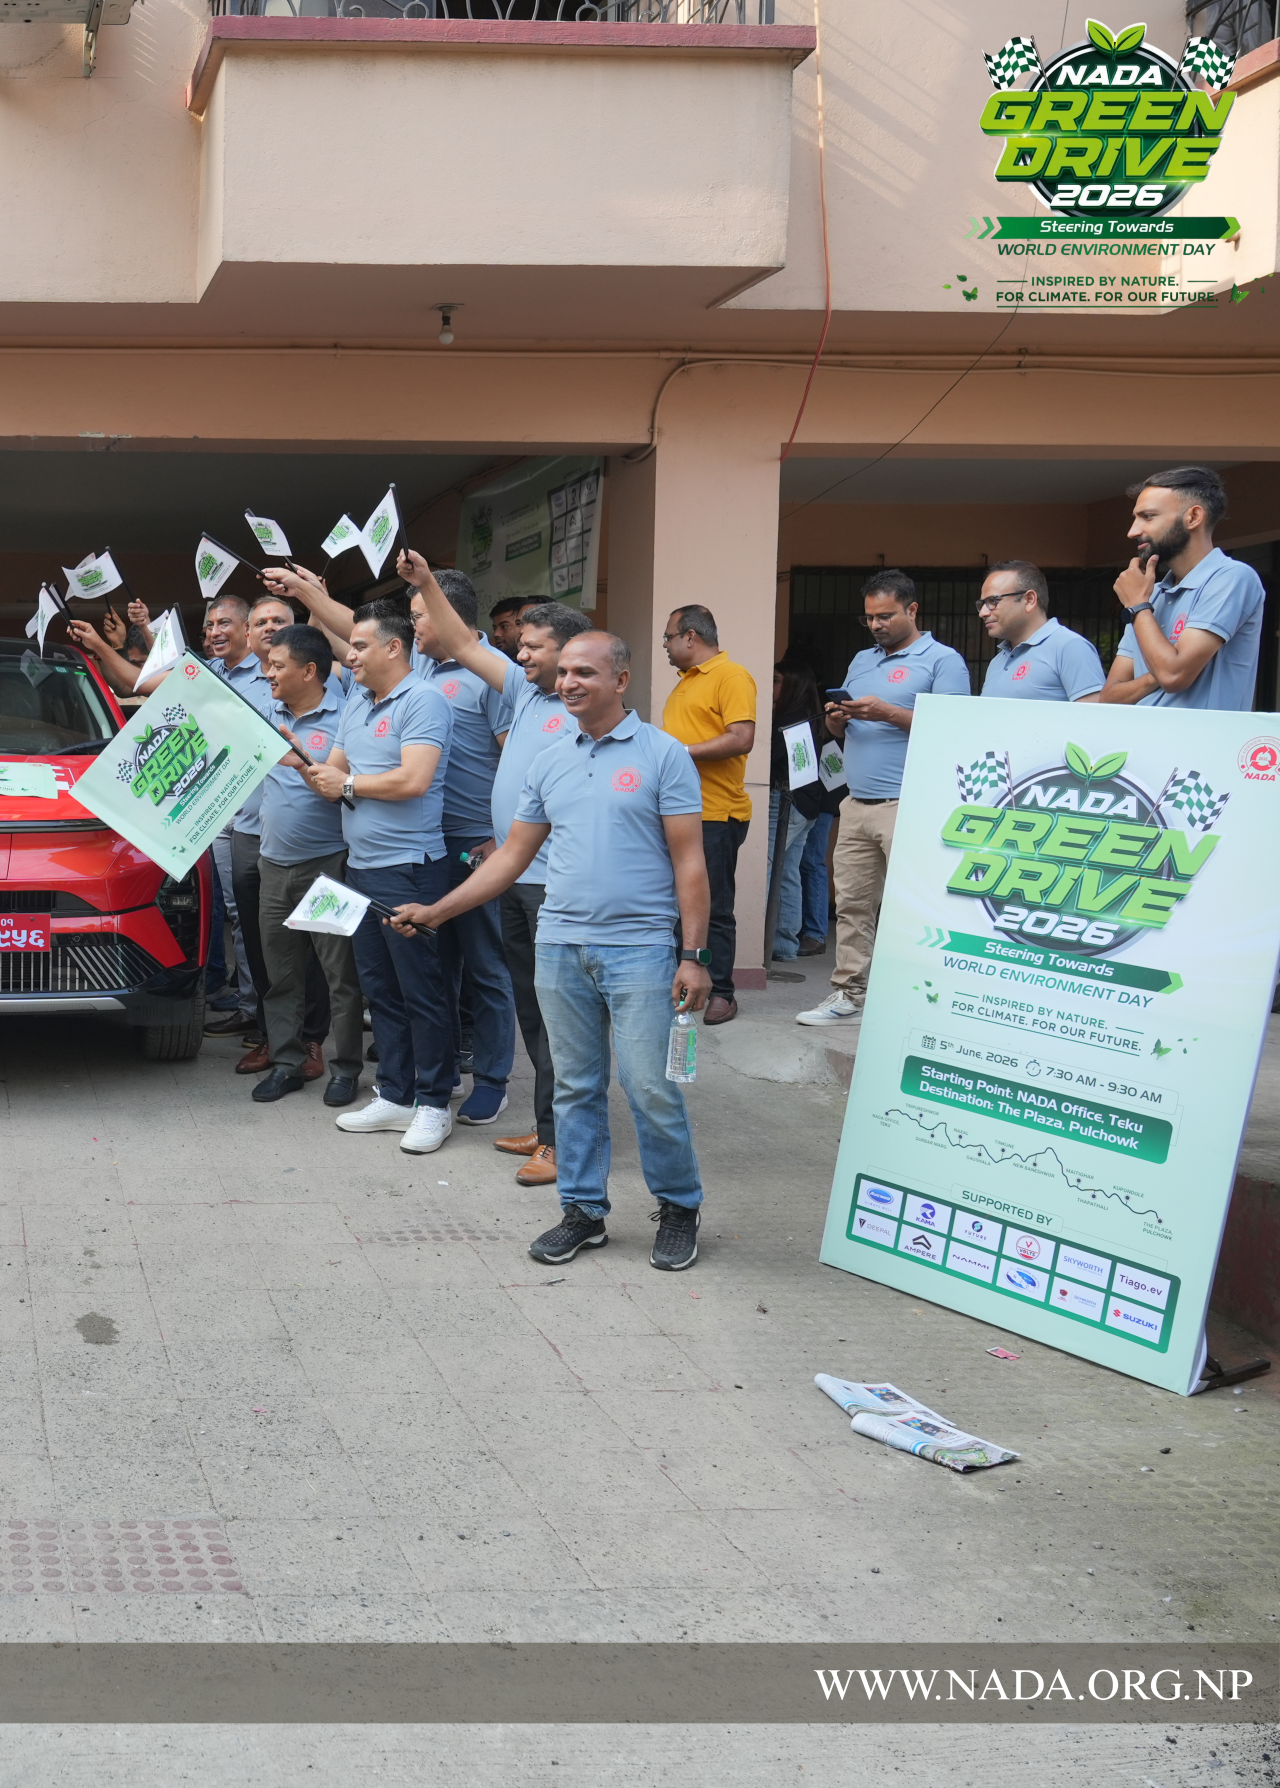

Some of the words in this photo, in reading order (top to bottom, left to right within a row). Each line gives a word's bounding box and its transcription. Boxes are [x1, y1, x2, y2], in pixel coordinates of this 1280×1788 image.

[130, 713, 198, 798] GREEN
[138, 728, 170, 765] NADA
[147, 729, 208, 807] DRIVE
[173, 757, 205, 798] 2026
[1244, 772, 1276, 781] NADA
[189, 831, 200, 843] FOR
[200, 809, 219, 832] CLIMATE.
[219, 797, 228, 809] FOR
[227, 785, 238, 797] OUR
[237, 764, 256, 786] FUTURE.
[194, 802, 215, 827] INSPIRED
[214, 795, 222, 803] BY
[220, 774, 239, 796] NATURE.
[1020, 785, 1139, 819] NADA
[941, 804, 1222, 876] GREEN
[946, 851, 1194, 923] DRIVE
[0, 918, 14, 927] ०१
[994, 905, 1120, 945] 2026
[984, 941, 1045, 966] Steering
[1049, 953, 1115, 977] Towards
[943, 956, 997, 976] WORLD
[999, 968, 1116, 1001] ENVIRONMENT
[1117, 991, 1154, 1009] DAY
[951, 1000, 975, 1013] FOR
[977, 1006, 1028, 1026] CLIMATE.
[1032, 1018, 1057, 1032] FOR
[1060, 1025, 1086, 1039] OUR
[1089, 1031, 1142, 1051] FUTURE.
[982, 994, 1034, 1013] INSPIRED
[1038, 1007, 1053, 1017] BY
[1056, 1011, 1108, 1030] NATURE.
[940, 1040, 954, 1051] 5th
[986, 1051, 1018, 1068] 2026
[921, 1065, 974, 1089] Starting
[976, 1080, 1014, 1099] Point:
[1017, 1090, 1058, 1111] NADA
[1108, 1114, 1144, 1134] Teku
[1046, 1066, 1073, 1081] 7:30
[1075, 1074, 1096, 1087] AM
[1108, 1082, 1138, 1097] 9:30
[1140, 1091, 1163, 1104] AM
[919, 1081, 995, 1110] Destination:
[998, 1101, 1021, 1117] The
[1069, 1121, 1139, 1150] Pulchowk
[915, 1216, 936, 1227] KAMA
[961, 1190, 1034, 1221] SUPPORTED
[1036, 1214, 1053, 1226] BY
[867, 1223, 891, 1237] DEEPAL
[964, 1229, 987, 1241] FUTURE
[904, 1245, 937, 1260] AMPERE
[952, 1254, 990, 1270] NAMMI
[1019, 1248, 1036, 1258] VOLTS
[1063, 1255, 1103, 1274] SKYWORTH
[1119, 1274, 1163, 1296] Tiago.ev
[1122, 1313, 1158, 1331] SUZUKI
